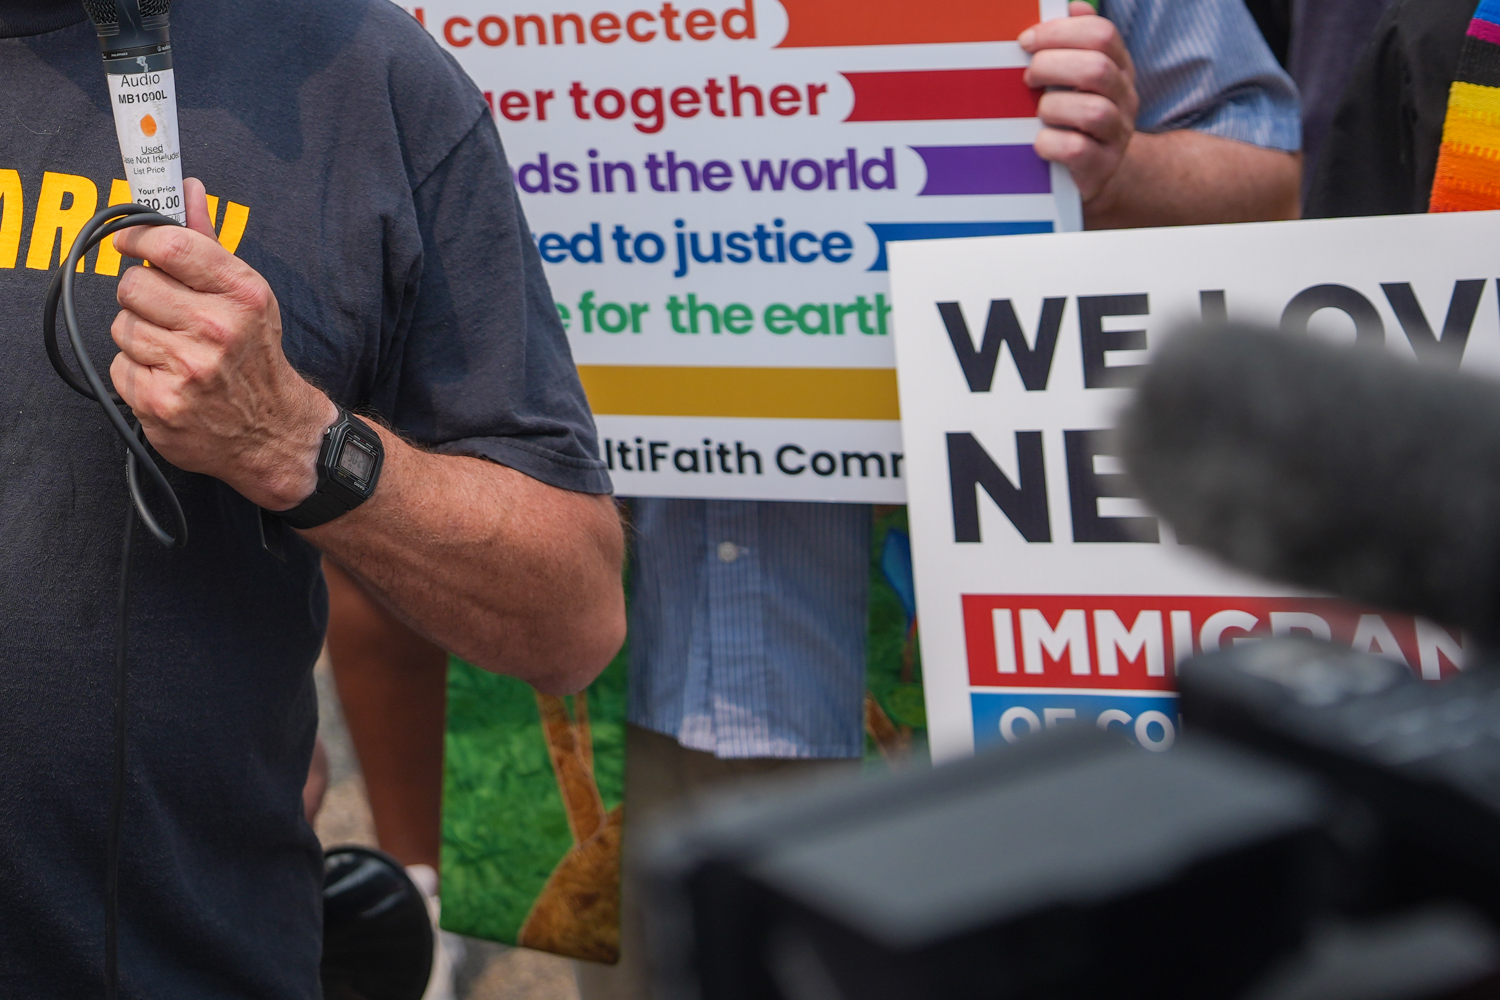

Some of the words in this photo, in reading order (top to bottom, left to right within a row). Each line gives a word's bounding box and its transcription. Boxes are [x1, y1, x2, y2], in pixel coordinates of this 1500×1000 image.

[120, 72, 161, 88] Audio
[117, 89, 168, 105] MB1000L
[484, 89, 555, 122] er
[568, 73, 827, 134] together
[135, 155, 151, 165] Not
[140, 144, 164, 155] Used
[133, 167, 145, 175] List
[146, 166, 166, 175] Price
[510, 152, 581, 194] ds
[586, 148, 637, 193] in
[643, 150, 734, 193] the
[741, 147, 897, 192] world
[138, 187, 155, 196] Your
[157, 185, 176, 195] Price
[531, 221, 604, 265] ed
[611, 223, 667, 264] to
[673, 218, 854, 279] justice
[577, 290, 651, 335] for
[665, 292, 754, 335] the
[936, 293, 1151, 393] WE
[945, 429, 1190, 545] NE
